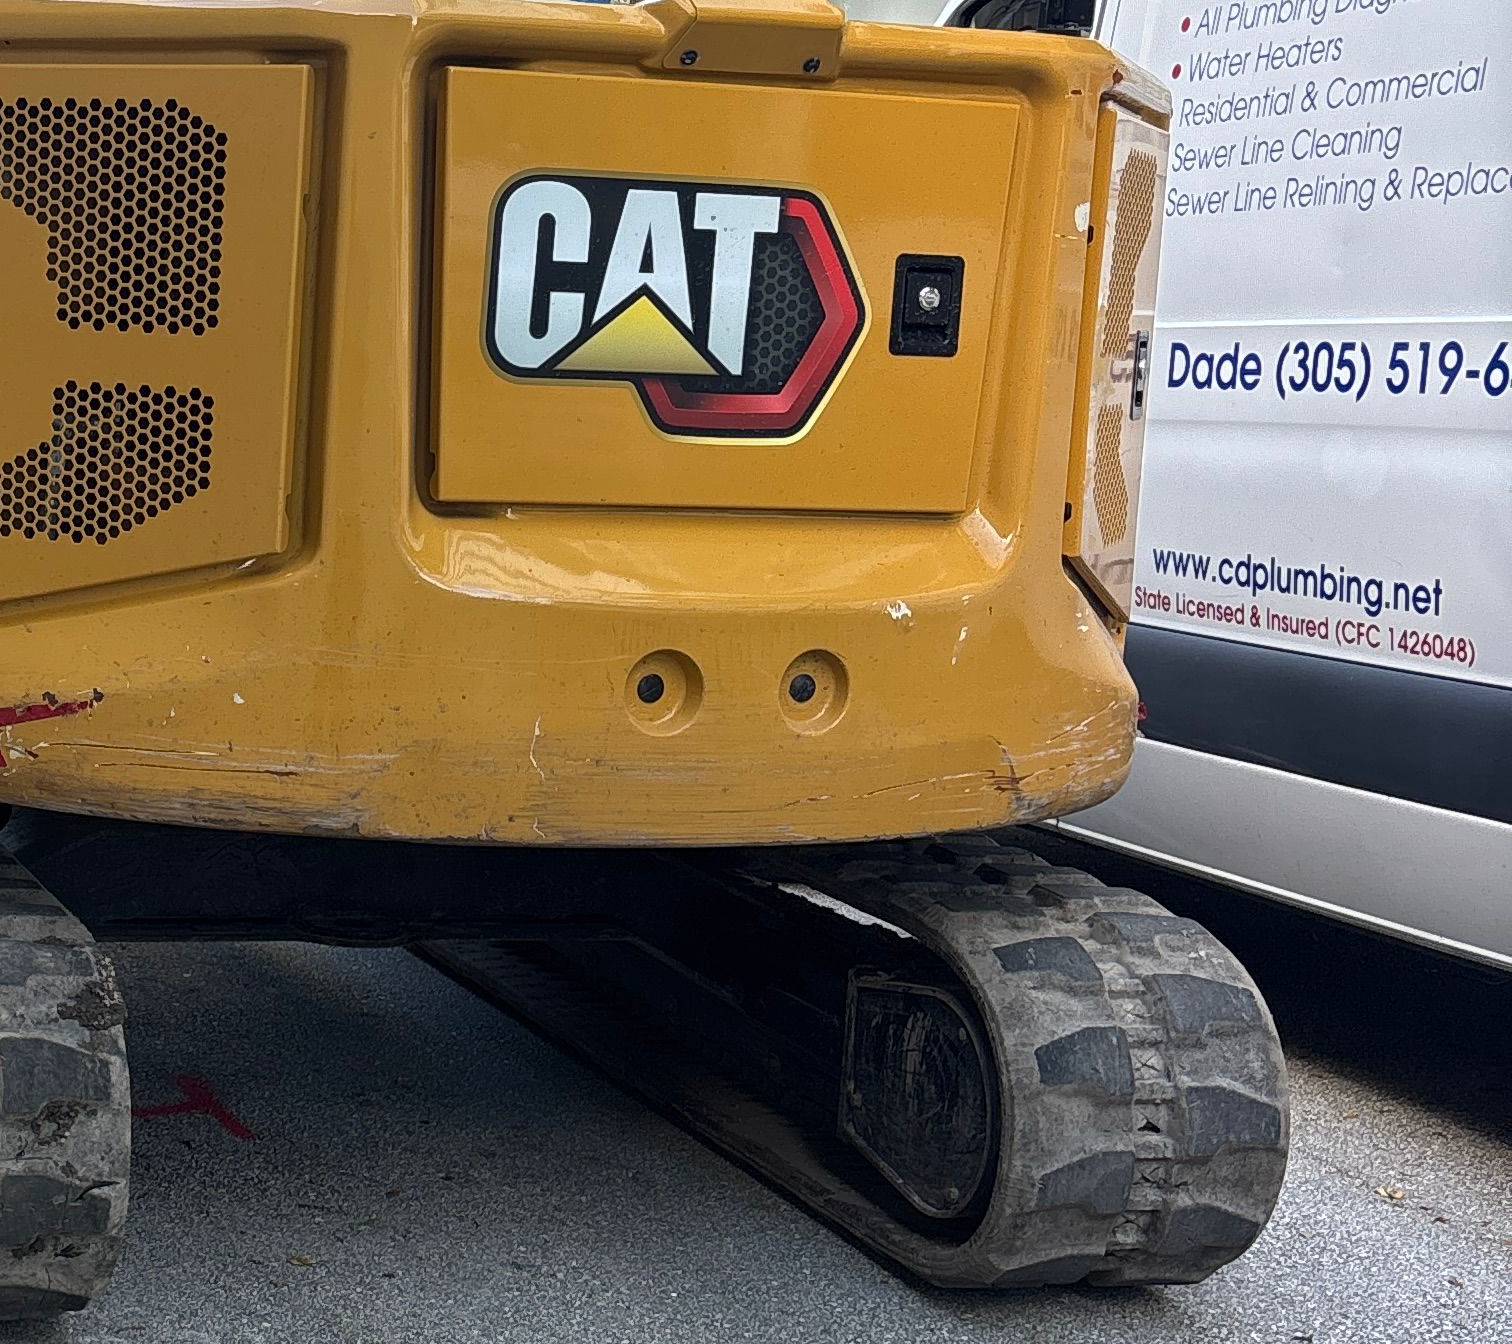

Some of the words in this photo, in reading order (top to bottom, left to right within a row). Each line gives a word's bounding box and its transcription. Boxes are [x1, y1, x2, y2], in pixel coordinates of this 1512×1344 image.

[1194, 6, 1222, 38] All
[1189, 48, 1251, 83] Water
[1254, 35, 1343, 73] Heaters
[1178, 84, 1296, 127] Residential
[1301, 80, 1318, 113] &
[1326, 57, 1488, 109] Commercial
[1171, 142, 1237, 172] Sewer
[1241, 135, 1285, 166] Line
[1291, 122, 1403, 159] Cleaning
[1165, 187, 1230, 217] Sewer
[1234, 181, 1277, 212] Line
[1283, 173, 1376, 211] Relining
[1383, 168, 1402, 201] &
[1410, 162, 1512, 205] Replac
[494, 180, 781, 376] CAT
[1167, 342, 1262, 390] Dade
[1276, 340, 1371, 403] (305)
[1386, 340, 1512, 397] 519-6
[1153, 548, 1443, 617] www.cdplumbing.net
[1134, 585, 1171, 612] State
[1176, 592, 1245, 626] Licensed
[1250, 606, 1261, 628] &
[1266, 607, 1329, 640] Insured
[1335, 617, 1381, 649] (CFC
[1388, 626, 1476, 667] 1426048)
